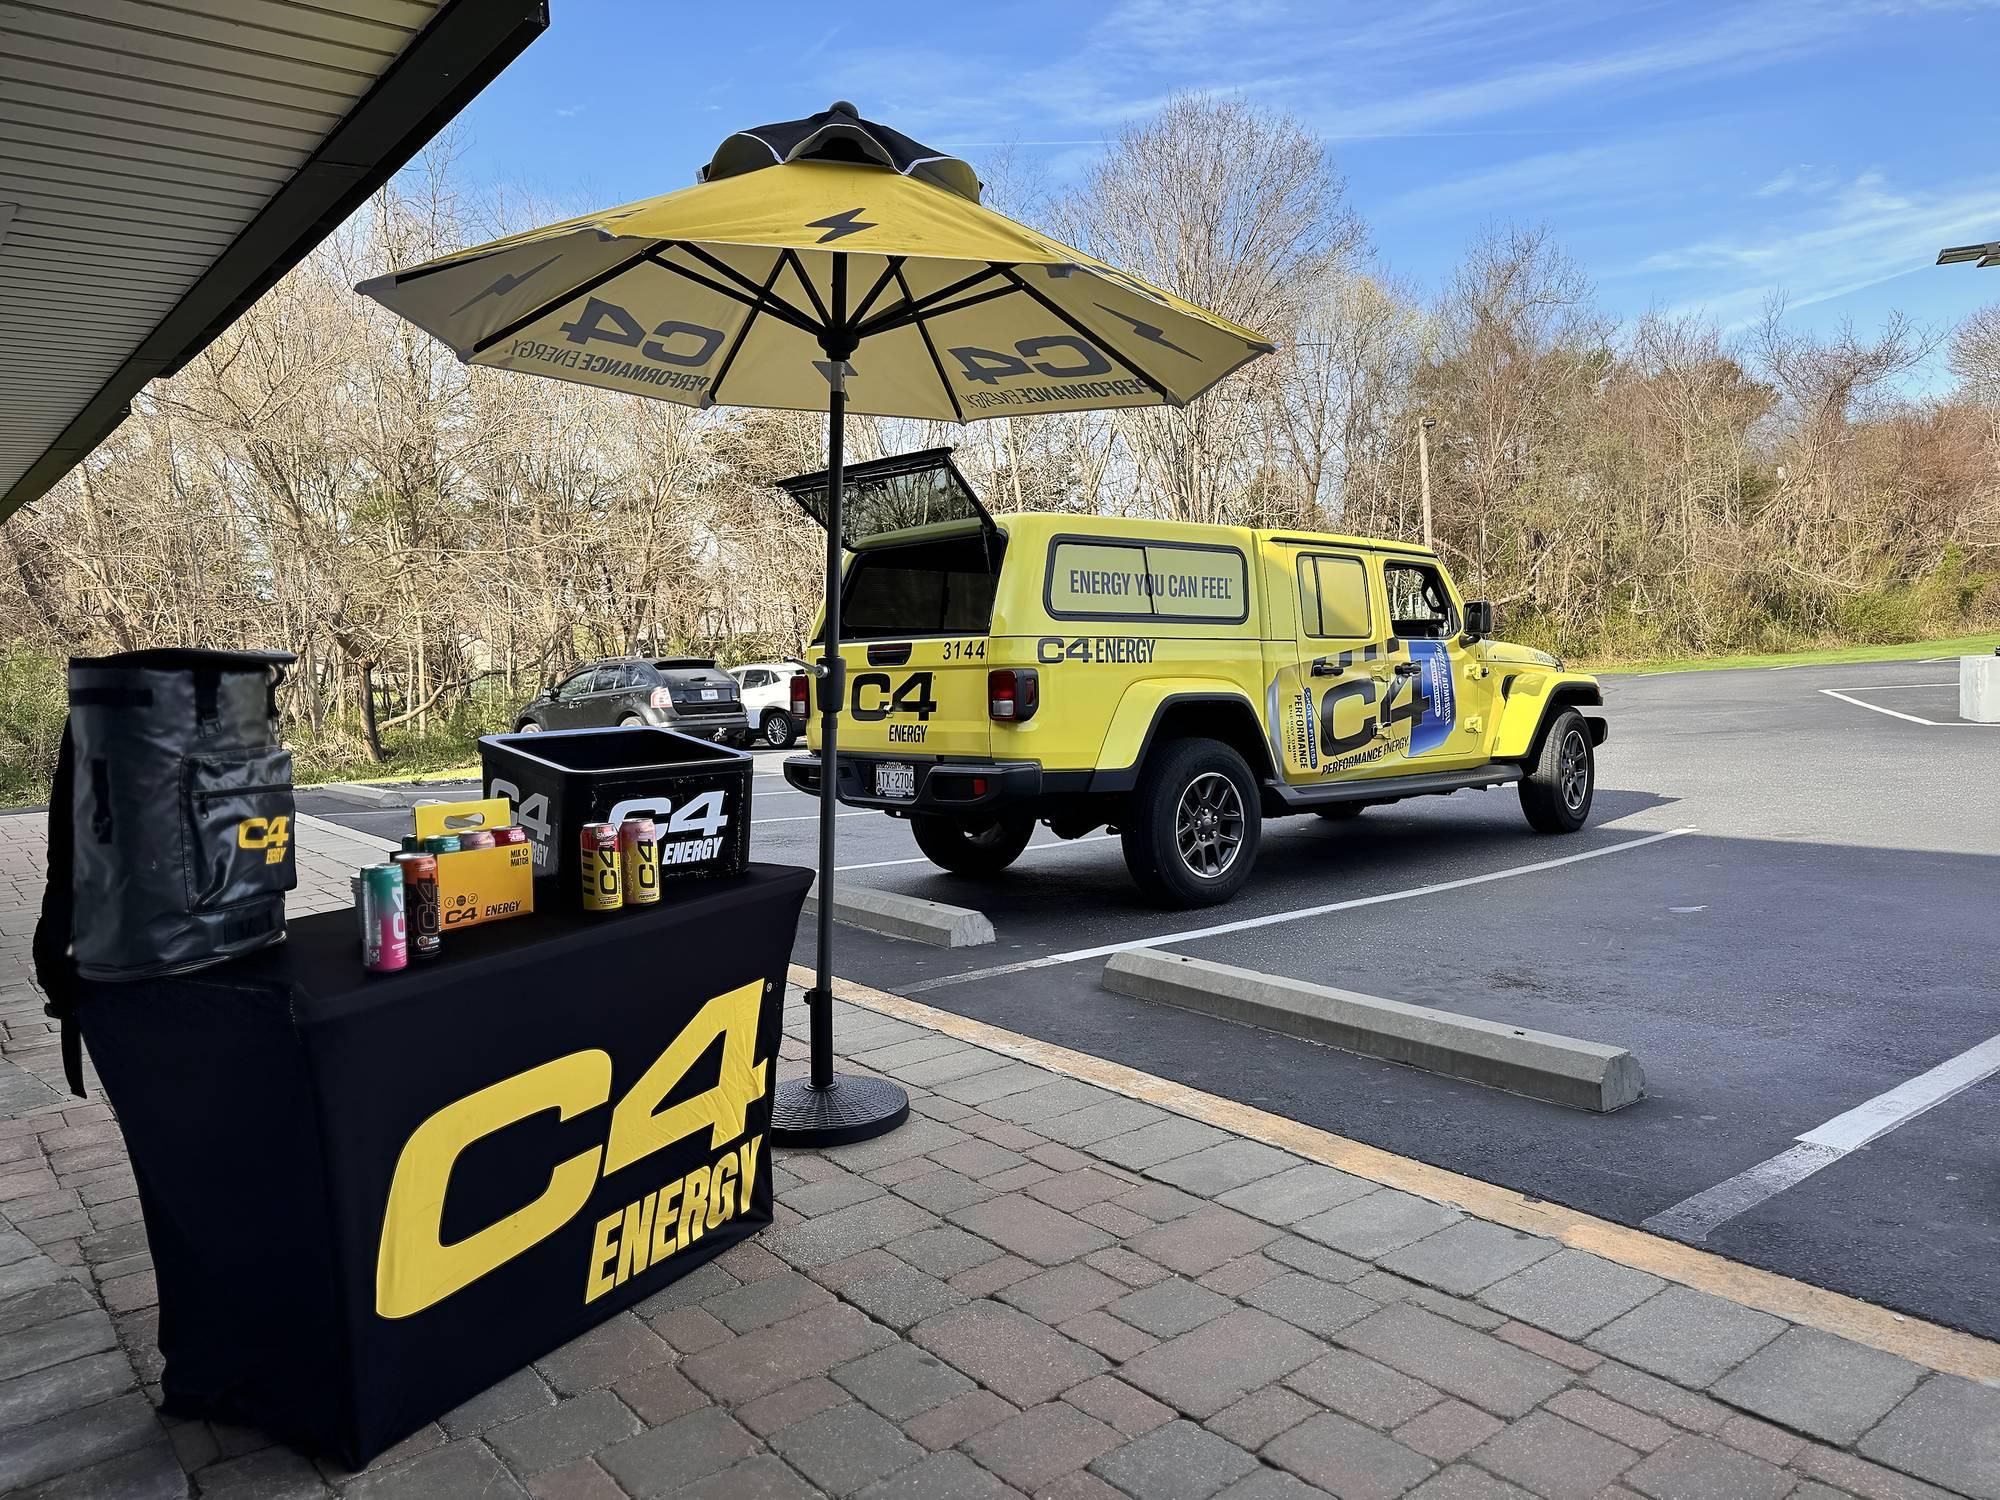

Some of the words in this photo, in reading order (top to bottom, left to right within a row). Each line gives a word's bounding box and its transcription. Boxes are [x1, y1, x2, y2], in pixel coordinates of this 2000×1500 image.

[1070, 570, 1131, 596] ENERGY
[1134, 573, 1165, 597] YOU
[1168, 574, 1198, 598] CAN
[942, 640, 985, 660] 3144
[1036, 637, 1093, 664] C4
[1095, 638, 1157, 664] ENERGY
[851, 671, 937, 721] C4
[1320, 660, 1431, 757] C4
[888, 724, 929, 743] ENERGY
[1294, 694, 1308, 769] PERFORMANCE
[1321, 745, 1383, 776] PERFORMANCE
[238, 816, 289, 848] C4
[608, 790, 729, 841] C4
[598, 845, 617, 895] C4
[637, 838, 656, 889] C4
[661, 836, 724, 865] ENERGY
[416, 872, 439, 936] C4
[445, 907, 478, 925] C4
[484, 900, 522, 917] ENERGY
[375, 977, 768, 1320] C4
[585, 1132, 763, 1305] ENERGY
